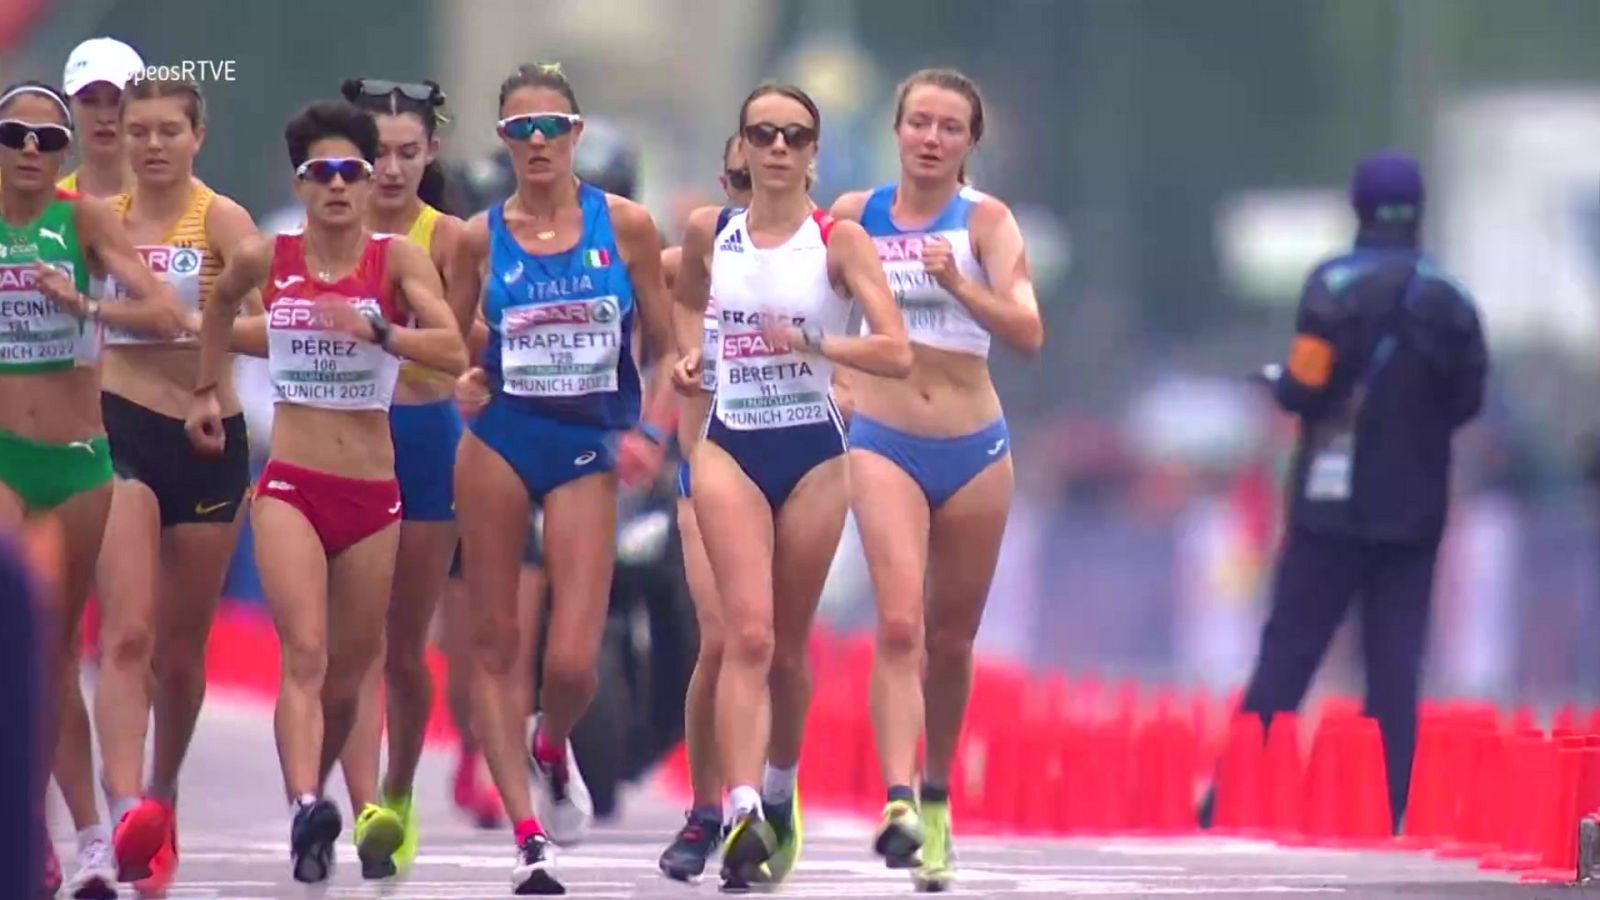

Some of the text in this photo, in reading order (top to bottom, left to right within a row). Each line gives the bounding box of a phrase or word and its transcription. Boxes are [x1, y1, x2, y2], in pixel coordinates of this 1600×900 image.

[0, 269, 38, 288] AR
[528, 275, 593, 299] ITALIA
[271, 308, 335, 328] SP
[722, 310, 806, 326] FRA
[291, 333, 359, 357] PÉREZ
[506, 332, 616, 350] TRAPLETTI
[729, 362, 813, 384] BERETTA
[275, 383, 375, 398] MUNICH 2022
[511, 378, 573, 392] MUNICH
[724, 405, 822, 424] MUNICH 2022
